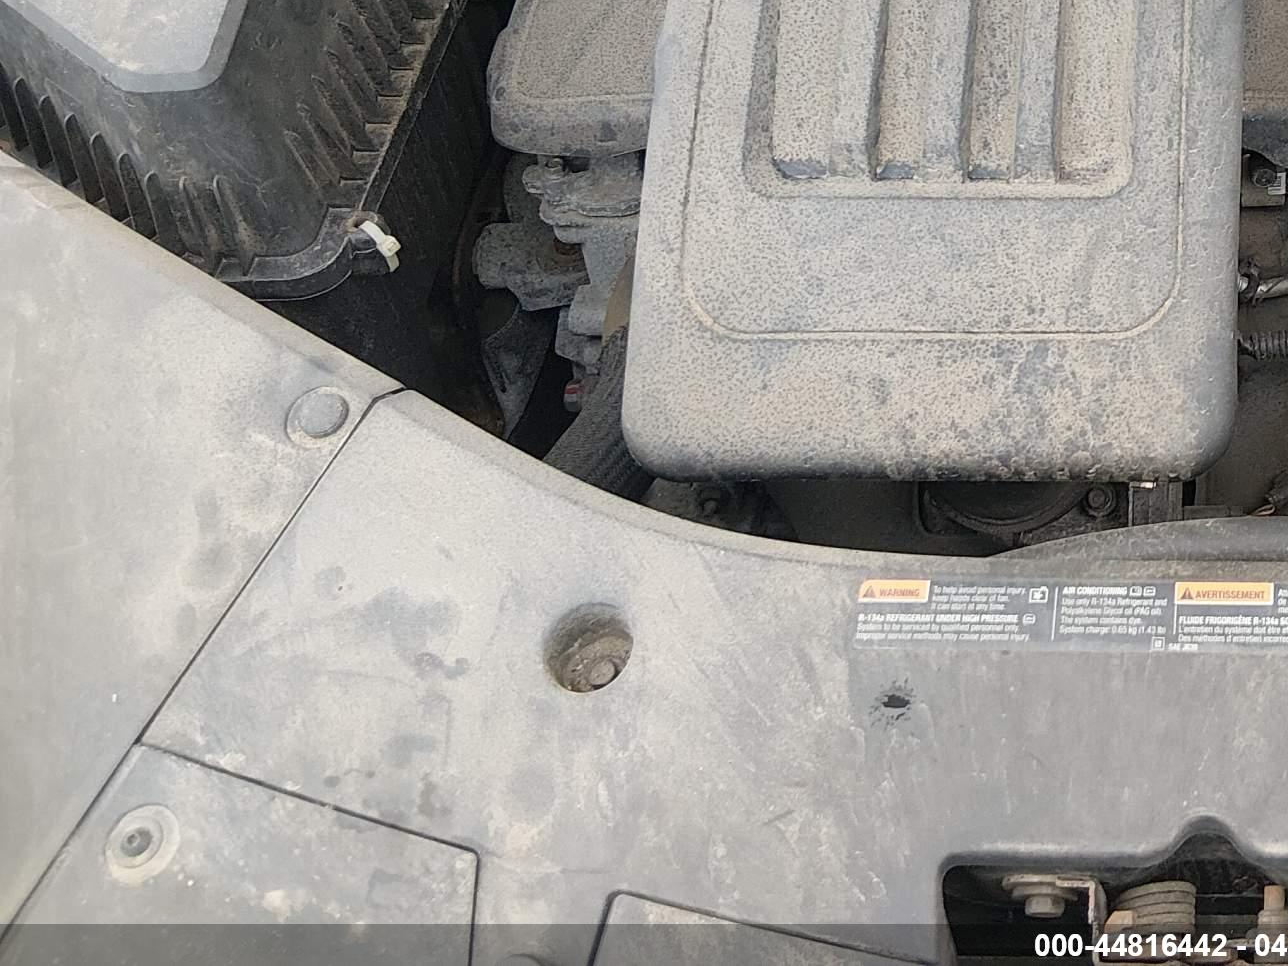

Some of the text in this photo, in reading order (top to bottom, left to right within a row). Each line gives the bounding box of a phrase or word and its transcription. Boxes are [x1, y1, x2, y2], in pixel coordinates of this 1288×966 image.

[880, 588, 920, 597] WARNING
[977, 586, 1006, 596] personal
[1063, 587, 1127, 595] AIR CONDITIONING
[1195, 590, 1264, 599] AVERTISSEMENT
[886, 614, 934, 623] REFRIGERANT
[936, 614, 961, 623] UNDER
[963, 614, 979, 623] HIGH
[981, 614, 1018, 623] PRESSURE
[1180, 616, 1203, 625] FLUIDE
